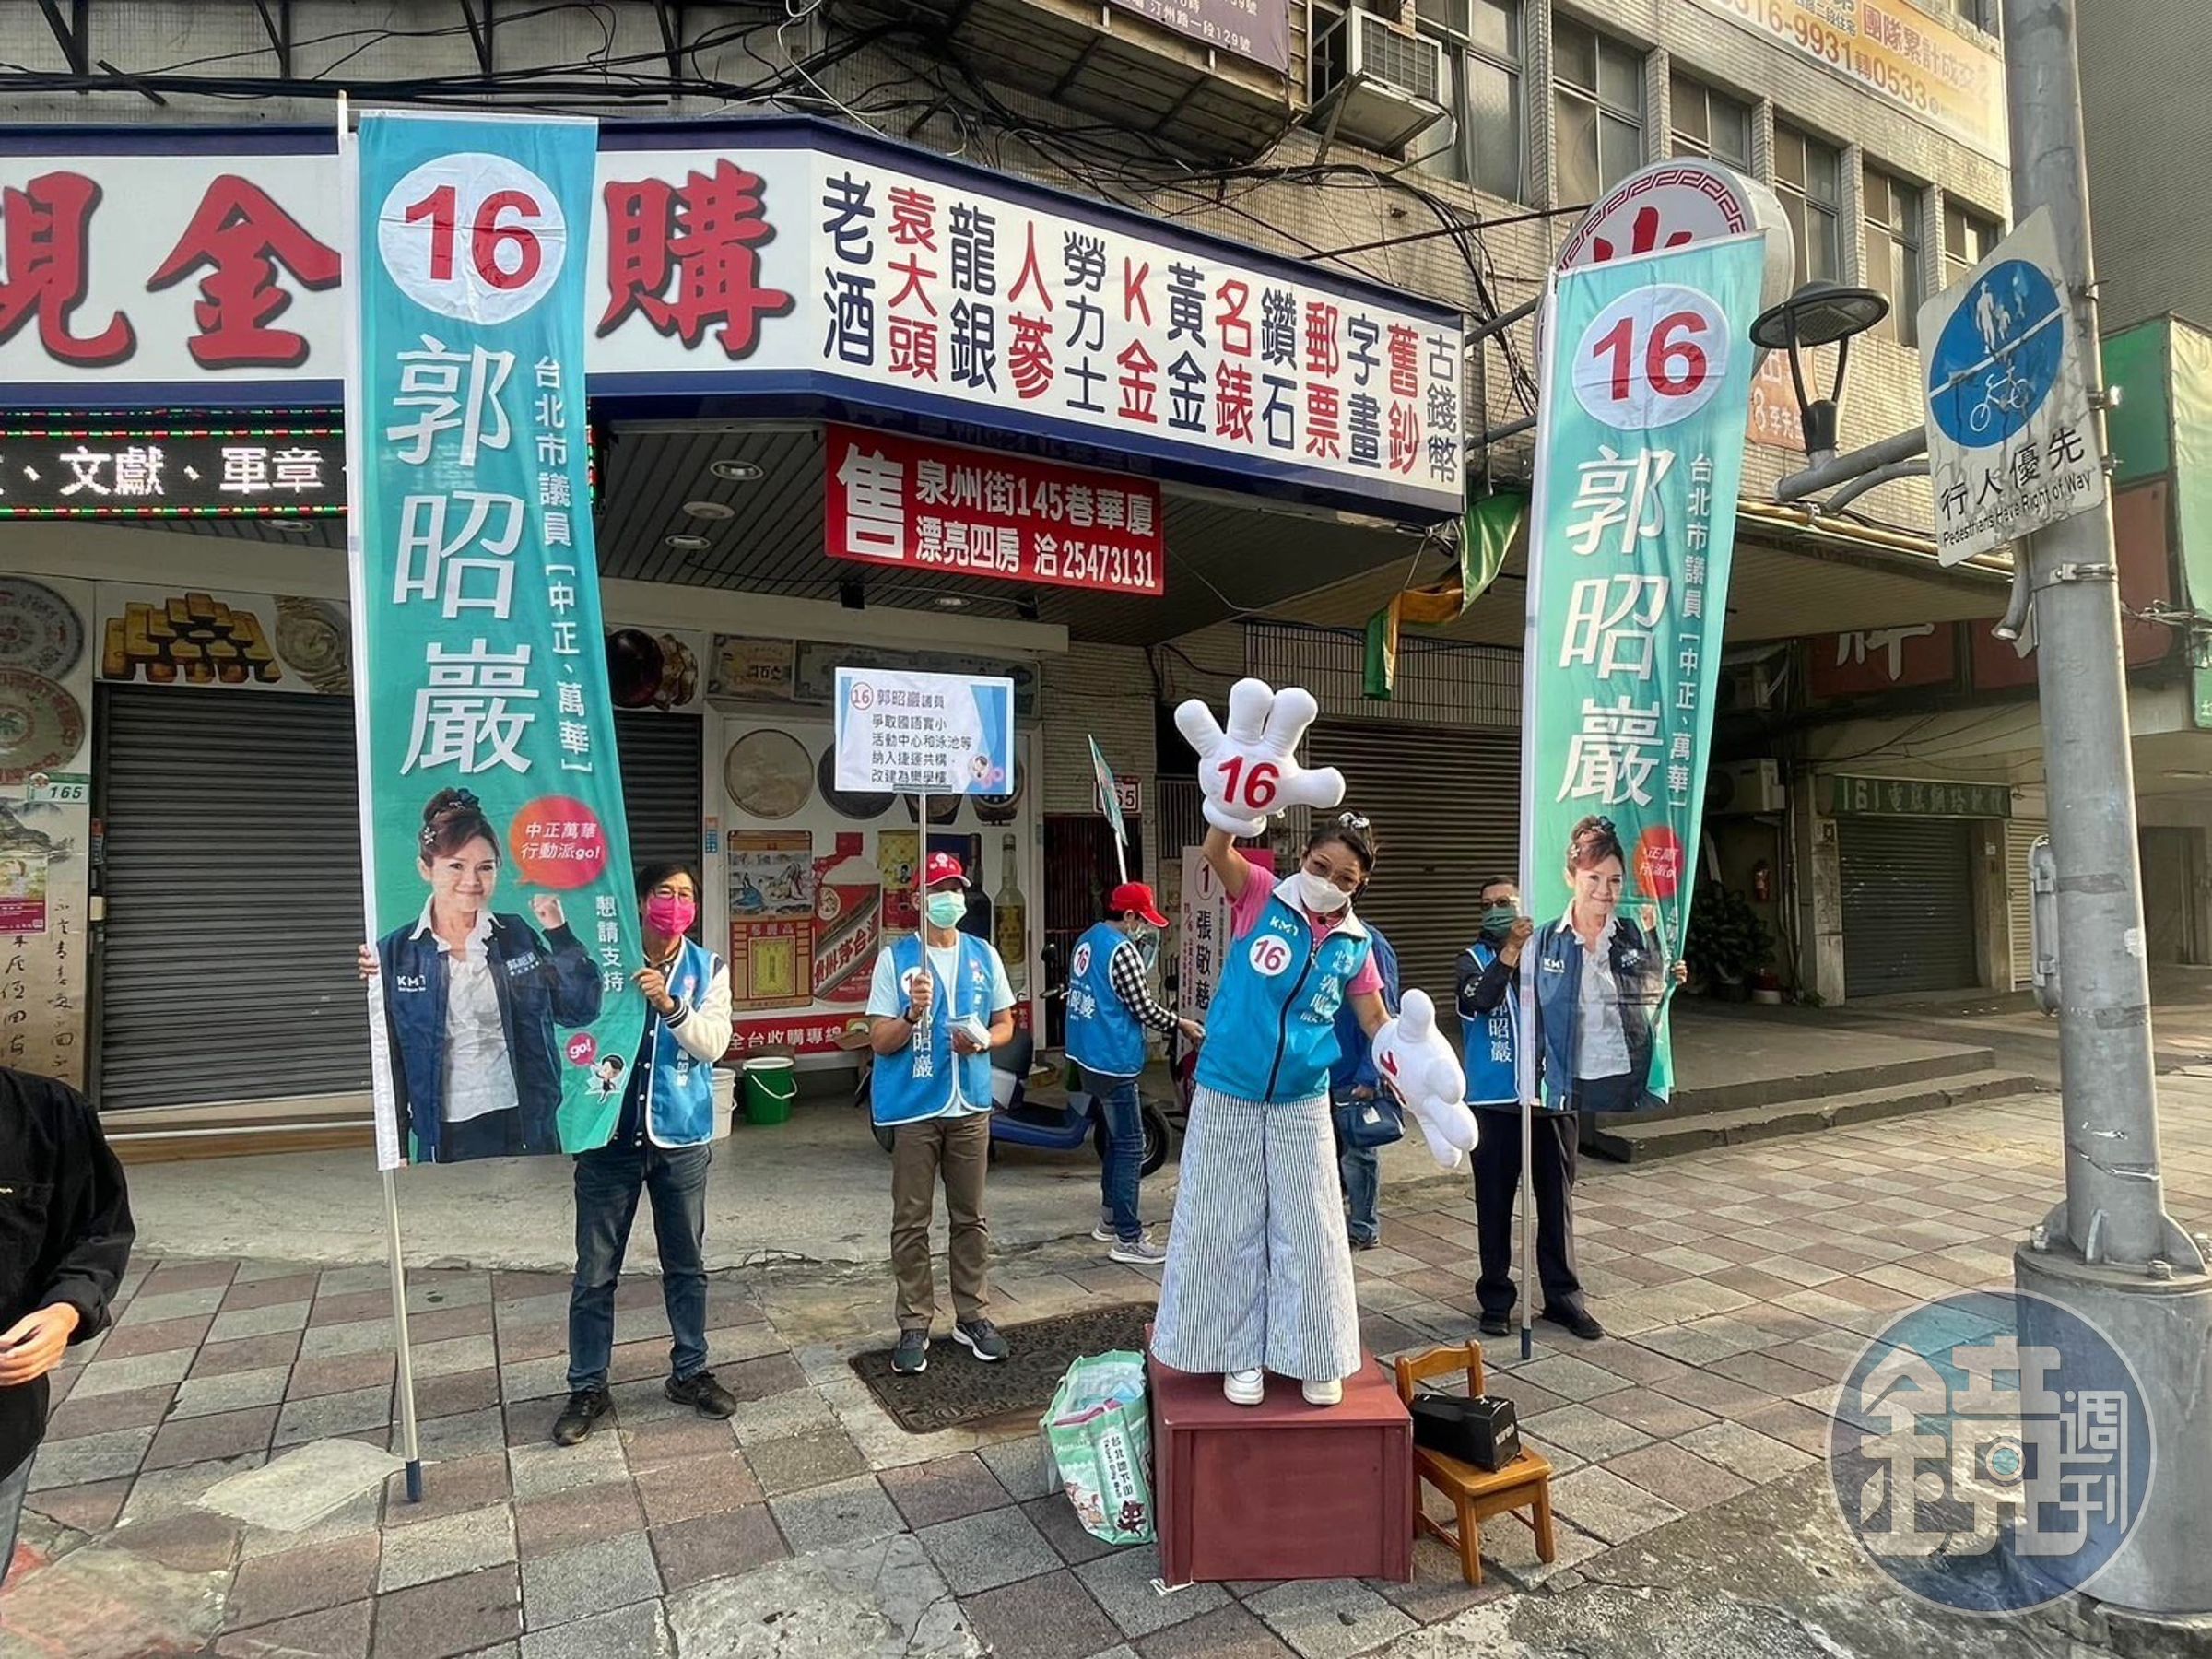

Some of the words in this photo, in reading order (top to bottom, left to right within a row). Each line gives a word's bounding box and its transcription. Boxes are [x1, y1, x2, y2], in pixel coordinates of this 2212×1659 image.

[1150, 2, 1252, 53] 汀州路一段129號
[406, 185, 542, 291] 16
[823, 172, 875, 366] 老酒
[888, 186, 938, 382] 袁大頭
[949, 202, 996, 393] 龍銀
[1064, 231, 1106, 413] 勞力士
[1117, 256, 1158, 423] K金
[1167, 262, 1206, 433] 黃金
[1216, 279, 1253, 444] 名錶
[1261, 287, 1297, 450] 鑽石
[1305, 301, 1340, 459] 郵票
[1347, 313, 1381, 469] 字畫
[1388, 323, 1419, 474] 舊鈔
[1427, 335, 1458, 483] 古錢幣
[1593, 311, 1707, 400] 16
[836, 443, 904, 559] 售
[915, 459, 1155, 538] 泉州街145巷華廈
[1941, 428, 2085, 521] 行人優先
[1943, 513, 1994, 548] Pedestrians
[1996, 501, 2019, 524] Have
[2053, 478, 2063, 499] of
[2065, 468, 2092, 491] Way
[386, 333, 539, 775] 郭昭巖
[915, 516, 1020, 574] 漂亮四房
[1556, 444, 1676, 806] 郭昭巖
[853, 689, 871, 704] 16
[51, 786, 82, 799] 165
[526, 822, 597, 839] 中正萬華
[1218, 755, 1280, 809] 16
[596, 896, 624, 992] 懇請支持
[1077, 948, 1089, 971] 16
[1254, 939, 1285, 971] 16
[570, 1039, 592, 1058] go!
